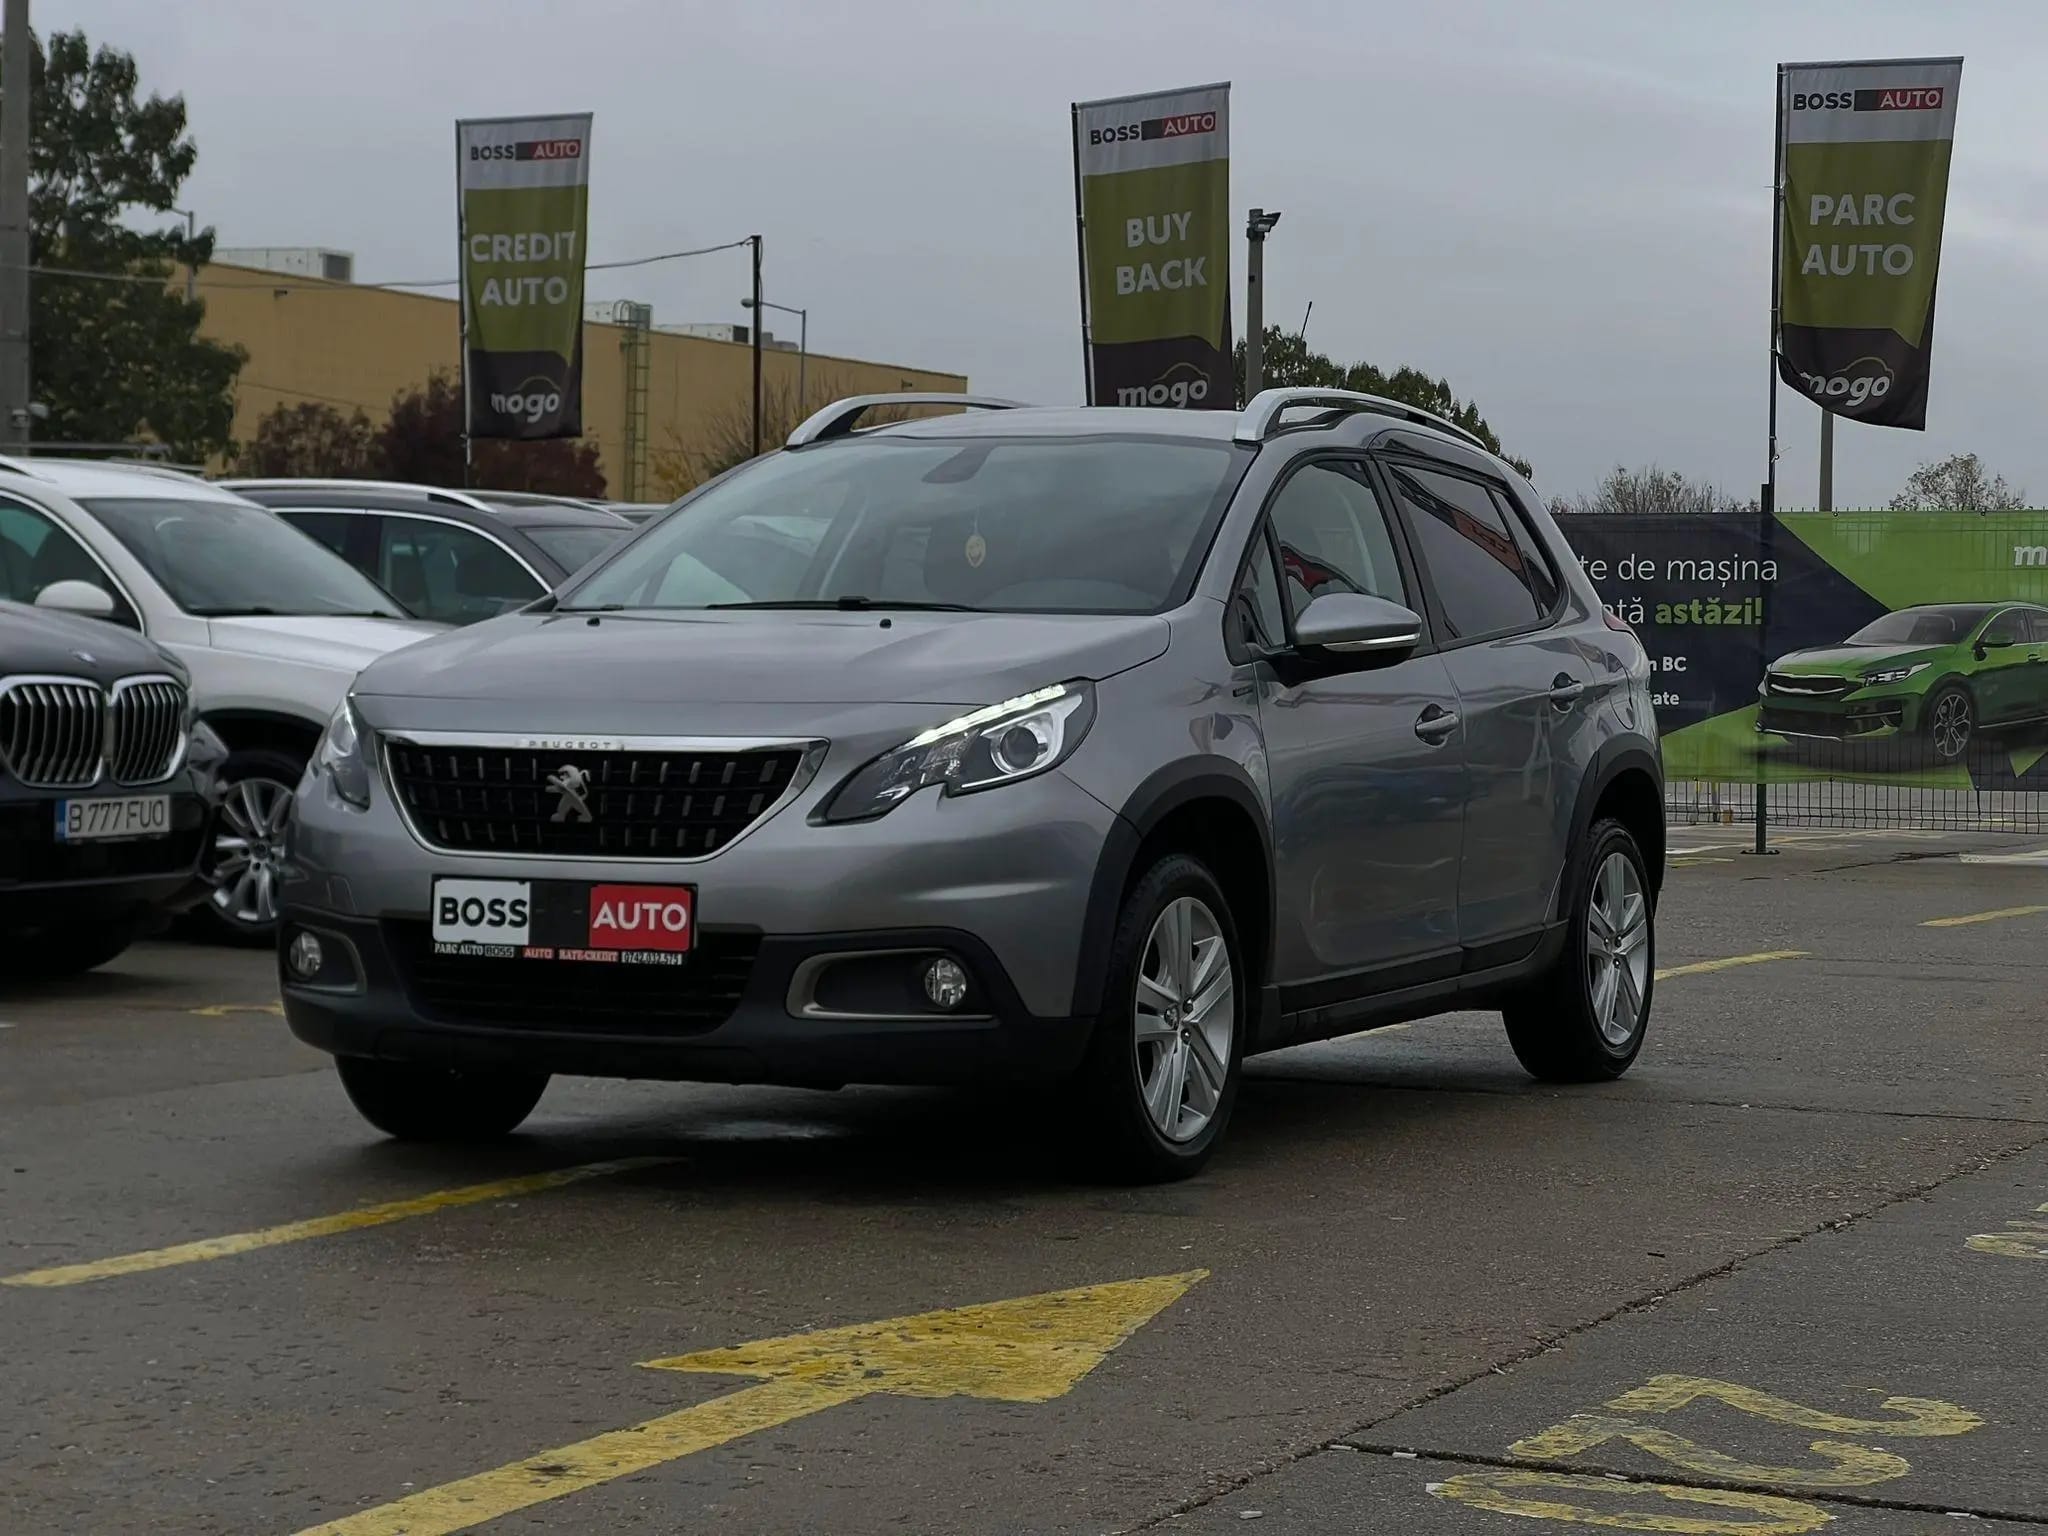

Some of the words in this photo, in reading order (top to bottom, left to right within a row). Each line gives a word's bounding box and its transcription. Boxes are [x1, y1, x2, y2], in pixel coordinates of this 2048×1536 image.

[1792, 91, 1853, 111] BOSS
[1879, 88, 1942, 108] AUTO
[1090, 123, 1140, 145] BOSS
[1163, 114, 1214, 136] AUTO
[470, 145, 514, 161] BOSS
[532, 140, 579, 158] AUTO
[1809, 193, 1916, 226] PARC
[1126, 211, 1192, 248] BUY
[470, 230, 576, 263] CREDIT
[1801, 244, 1914, 276] AUTO
[1115, 256, 1207, 295] BACK
[479, 276, 569, 307] AUTO
[490, 392, 560, 424] mogo
[1116, 379, 1208, 409] mogo
[1618, 553, 1656, 580] de
[1666, 553, 1778, 588] mașina
[1655, 597, 1763, 625] astăzi!
[1662, 656, 1688, 672] BC
[1650, 691, 1681, 706] ate
[528, 740, 612, 750] PEUGEOT
[69, 804, 82, 833] B
[88, 801, 123, 833] 777
[126, 800, 164, 829] FUO
[439, 897, 528, 928] BOSS
[592, 902, 687, 931] AUTO
[434, 943, 458, 954] PARC
[459, 944, 483, 956] AUTO
[523, 947, 554, 959] AUTO
